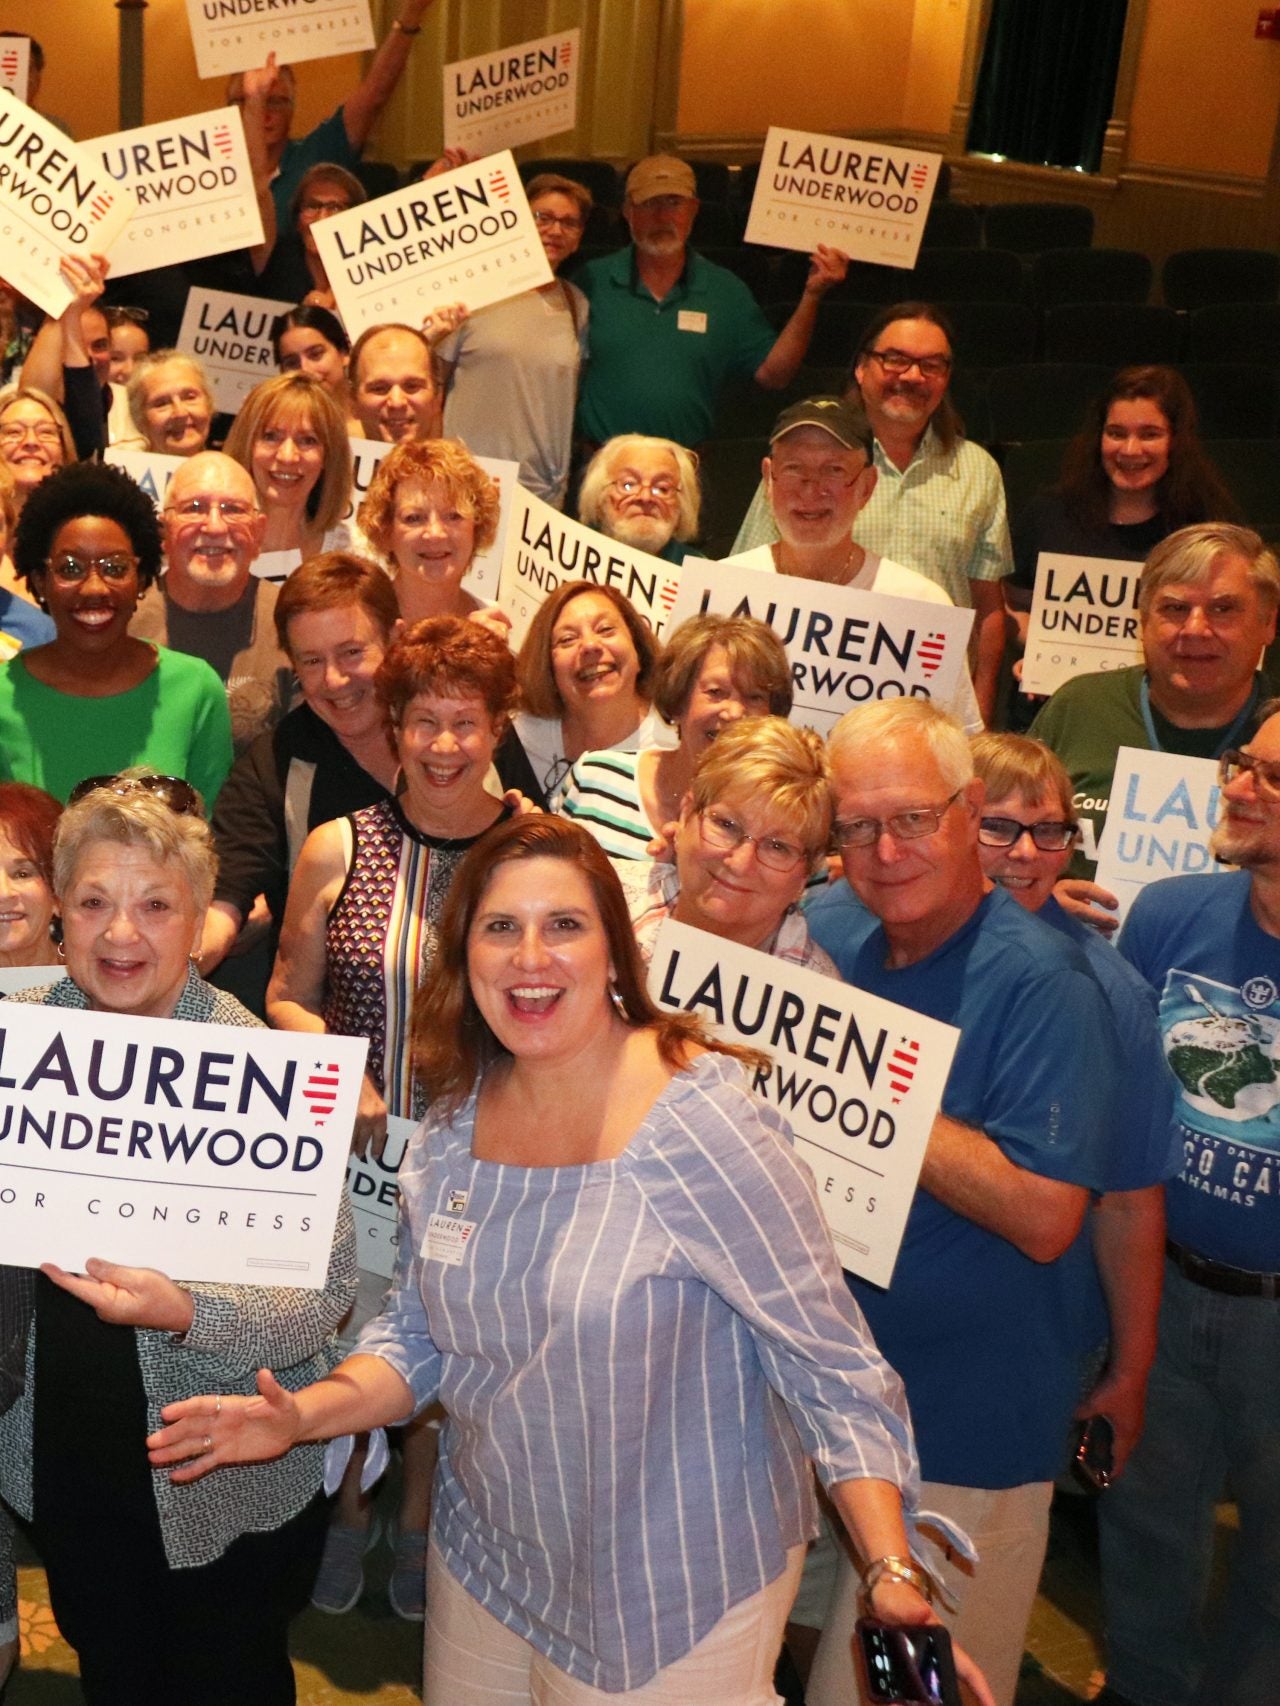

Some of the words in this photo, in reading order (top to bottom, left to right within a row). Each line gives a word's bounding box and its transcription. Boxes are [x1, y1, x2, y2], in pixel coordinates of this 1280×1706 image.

[258, 16, 360, 41] CONGRESS
[456, 46, 558, 96] LAUREN
[456, 72, 569, 118] UNDERWOOD
[102, 130, 212, 181] UREN
[778, 141, 910, 189] LAUREN
[130, 166, 237, 205] RWOOD
[773, 173, 919, 215] UNDERWOOD
[128, 207, 246, 241] CONGRESS
[334, 178, 490, 260] LAUREN
[766, 209, 799, 222] FOR
[814, 218, 911, 243] CONGRESS
[347, 209, 518, 286] UNDERWOOD
[361, 297, 398, 317] FOR
[417, 248, 531, 296] CONGRESS
[198, 303, 276, 342] LAU
[194, 336, 271, 366] UNDER
[1045, 569, 1140, 610] LAU
[1042, 609, 1139, 640] UNDER
[1037, 653, 1077, 667] FOR
[659, 949, 889, 1091] LAUREN
[752, 1062, 896, 1149] RWOOD
[1227, 1146, 1257, 1161] DAY
[1178, 1170, 1255, 1207] AHAMAS
[1233, 1161, 1280, 1195] CA
[88, 1199, 312, 1233] CONGRESS
[429, 1217, 464, 1231] LAUREN
